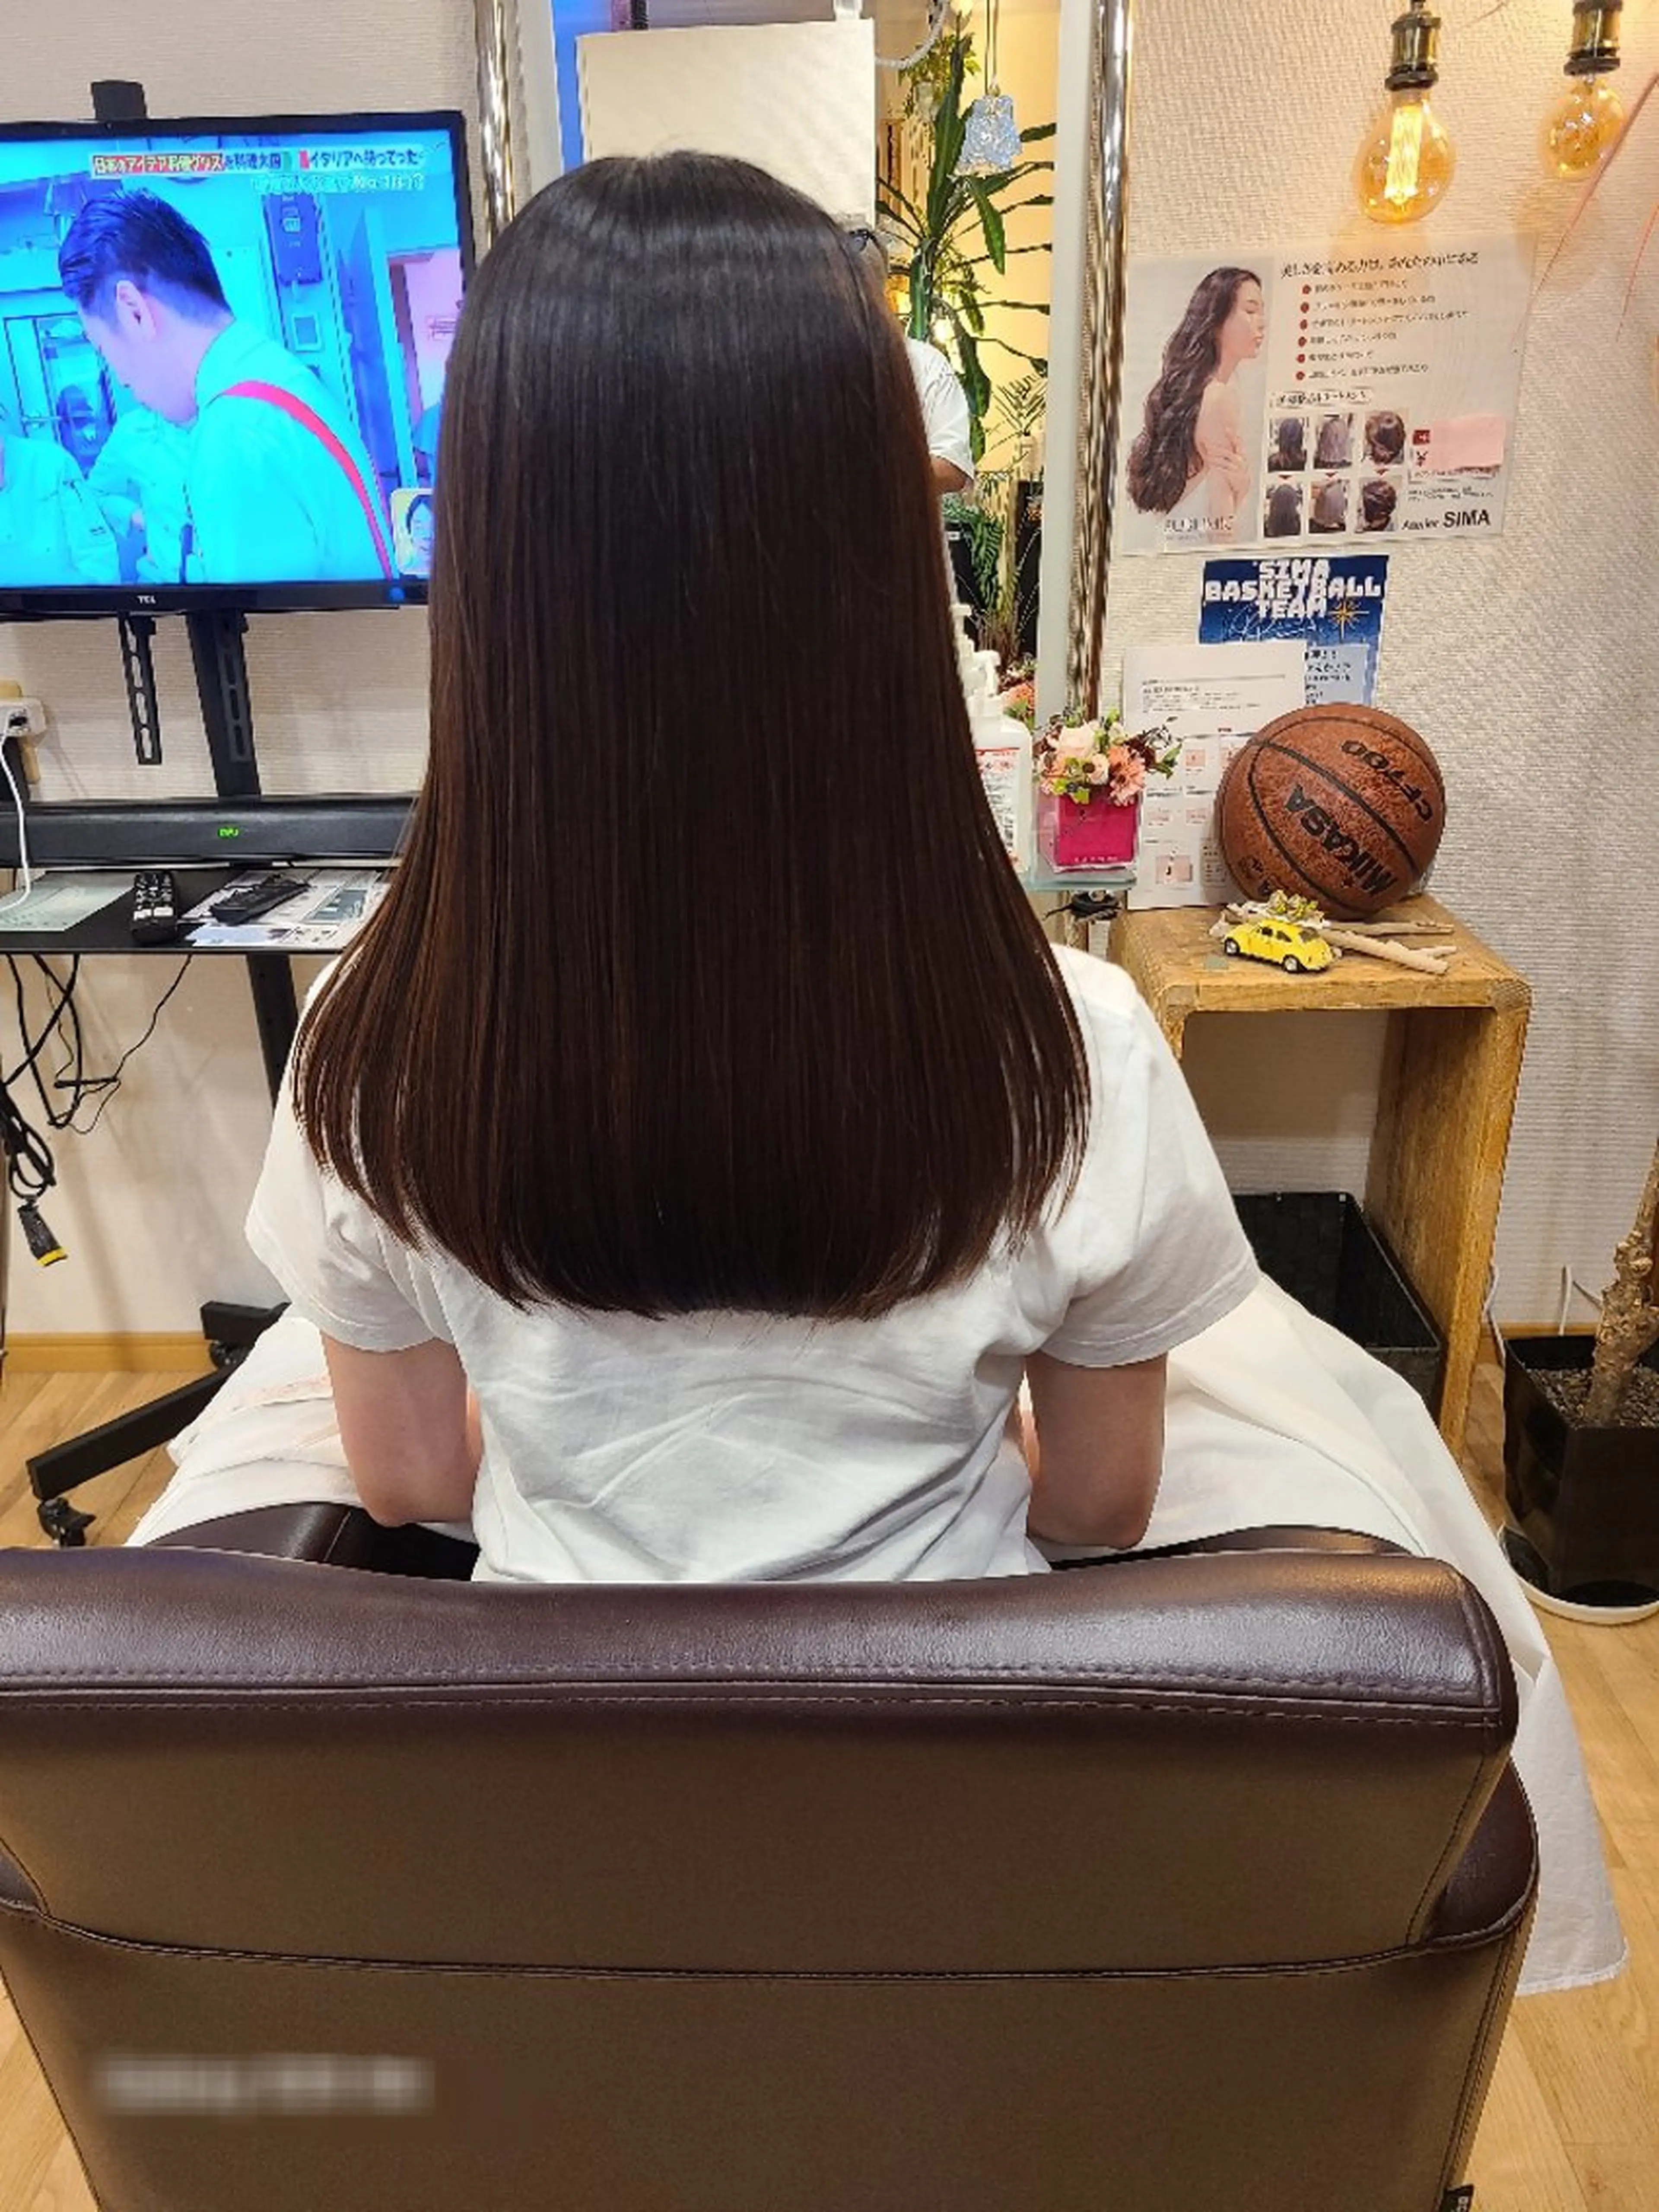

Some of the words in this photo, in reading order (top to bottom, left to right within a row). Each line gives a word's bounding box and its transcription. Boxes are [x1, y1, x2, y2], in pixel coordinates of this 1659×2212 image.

[1443, 509, 1491, 528] SIMA
[1258, 558, 1330, 580] SIMA
[137, 595, 156, 604] TCL
[1205, 576, 1382, 602] BASKETBALL
[1255, 597, 1328, 619] TEAM
[1284, 784, 1399, 895] MIKASA
